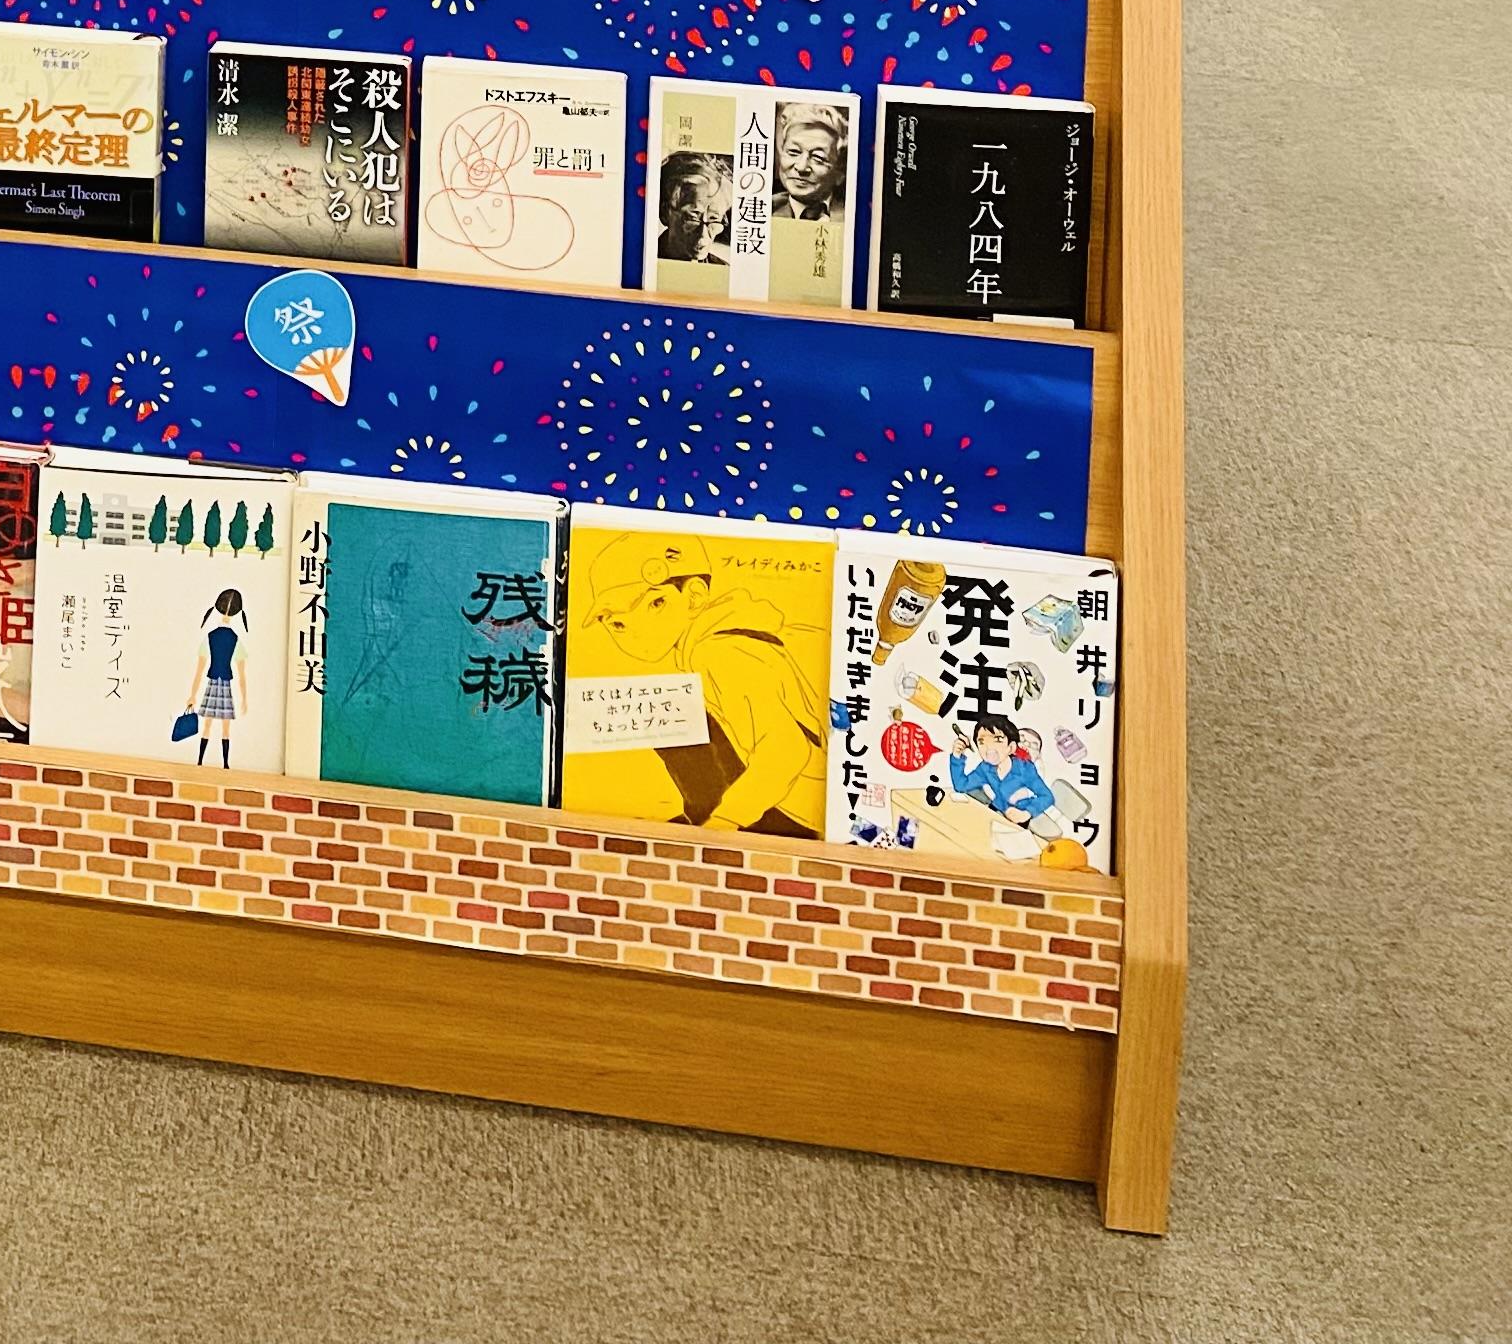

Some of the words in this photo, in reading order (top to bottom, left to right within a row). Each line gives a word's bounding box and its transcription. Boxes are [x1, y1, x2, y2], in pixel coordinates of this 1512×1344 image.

[322, 66, 358, 223] そこにいる
[360, 67, 402, 227] 殺人犯は
[484, 88, 572, 104] ドストエフスキー
[532, 146, 593, 172] 罪と罰
[24, 200, 54, 216] Simon
[55, 202, 86, 220] Singh
[41, 182, 66, 200] Last
[68, 184, 122, 204] Theorem
[735, 111, 771, 257] 人間の建設
[965, 141, 1009, 306] 一九八四年
[1060, 122, 1082, 254] ジョージ・オーウェル
[273, 296, 326, 347] 祭
[296, 520, 332, 696] 小野不由美
[720, 555, 823, 574] ブレイディみかこ
[60, 594, 76, 671] 瀬尾まいこ
[101, 572, 130, 701] 温室デイズ
[458, 570, 556, 717] 残穢
[580, 682, 695, 703] ぼくはイエローで
[841, 563, 877, 822] いただきました!
[938, 574, 1016, 724] 発注
[591, 716, 689, 734] ちょっとブルー
[605, 701, 685, 718] ホワイトで、
[1071, 587, 1110, 849] 朝井リョウ
